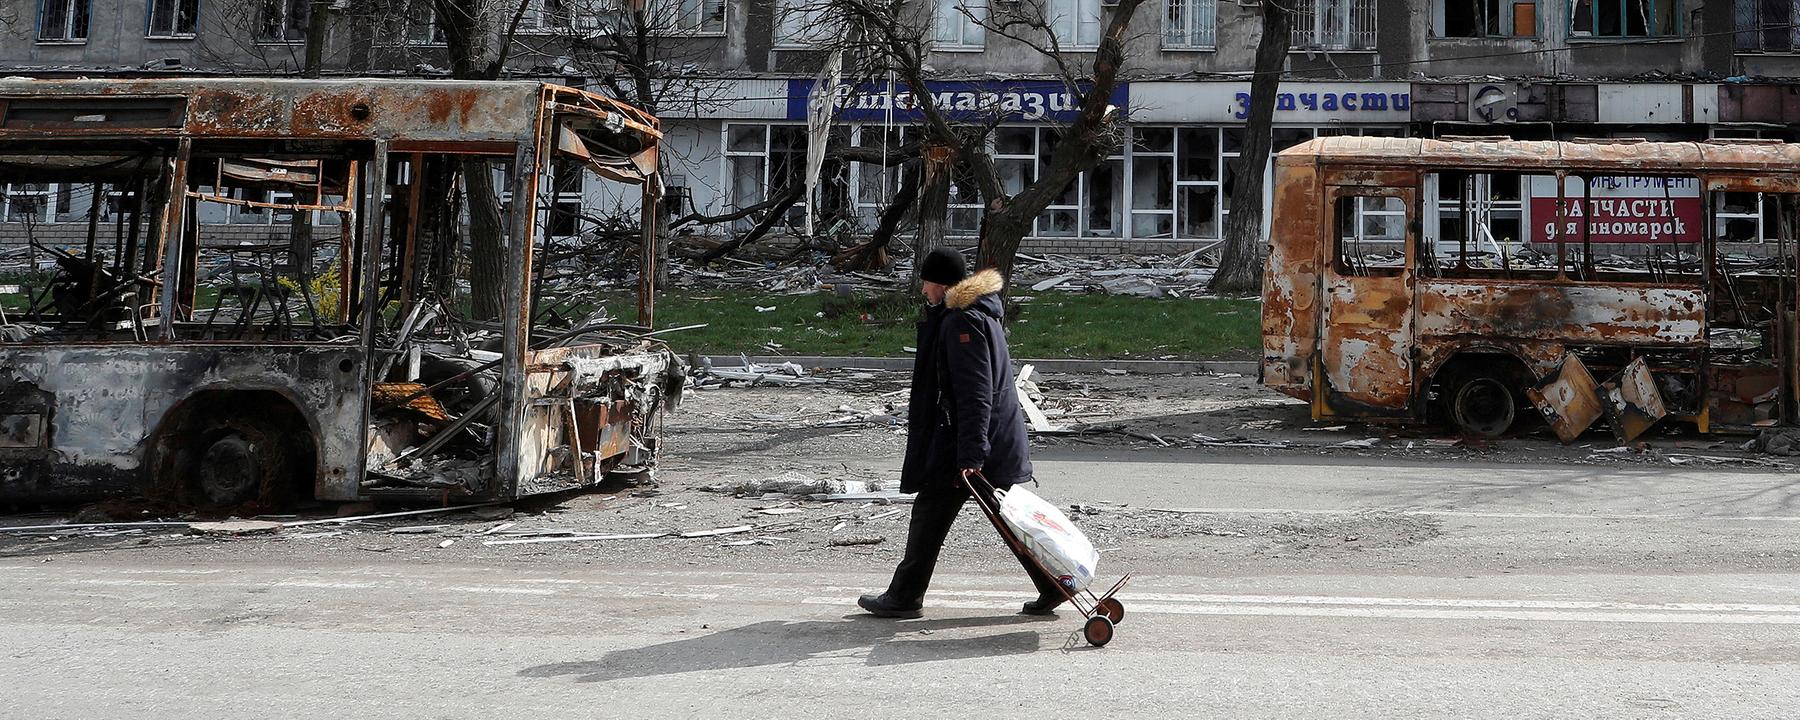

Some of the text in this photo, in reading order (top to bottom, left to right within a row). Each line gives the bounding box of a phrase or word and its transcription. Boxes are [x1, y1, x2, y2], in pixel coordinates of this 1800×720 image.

[810, 84, 1084, 120] автомагази
[1591, 176, 1693, 189] ИНСТРУМЕНТ
[1545, 217, 1686, 240] дя иномарок
